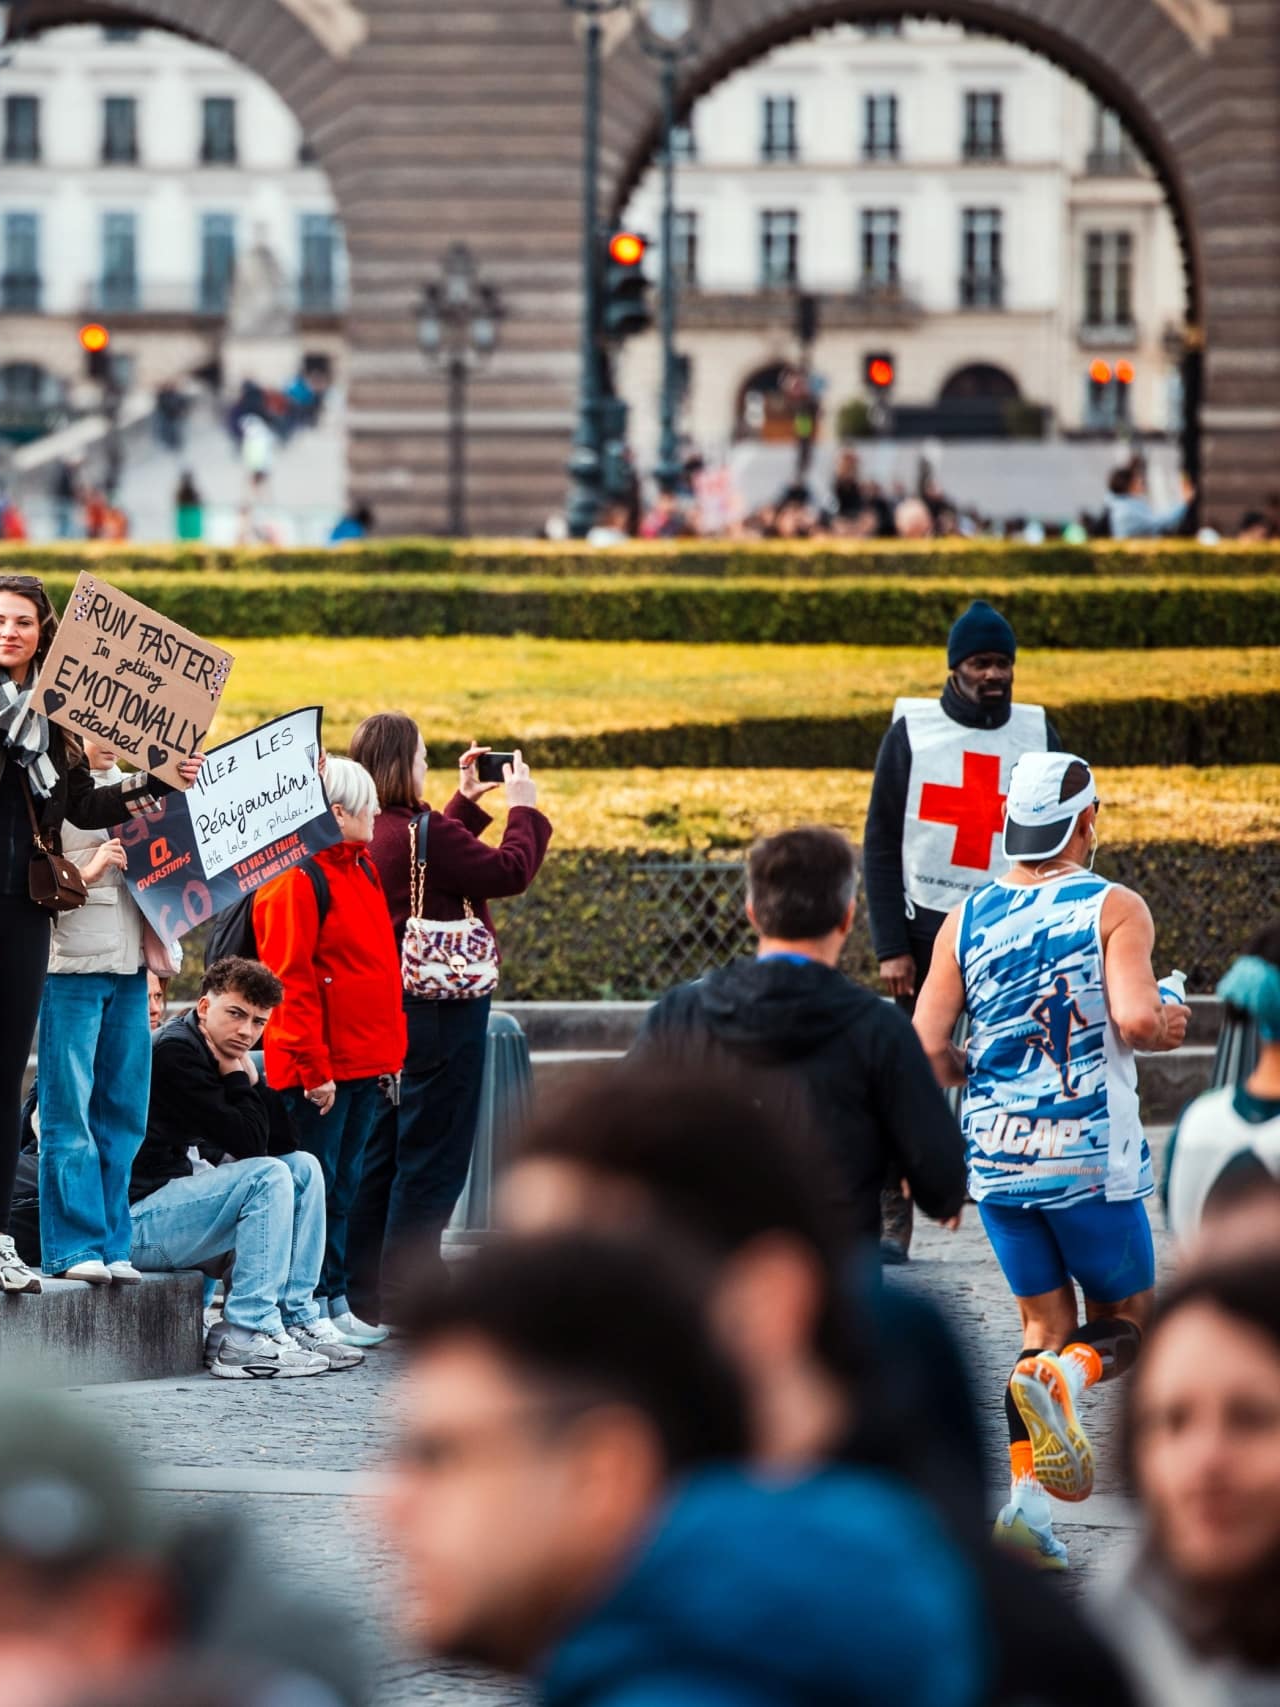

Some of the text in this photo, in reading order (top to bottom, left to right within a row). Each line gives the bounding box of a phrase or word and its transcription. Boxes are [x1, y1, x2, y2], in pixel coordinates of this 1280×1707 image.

[86, 594, 216, 690] RUN FASTER
[115, 658, 167, 694] getting
[54, 655, 207, 755] EMOTIONALLY
[69, 707, 145, 755] attached
[196, 727, 294, 796] LLEZ LES
[247, 852, 266, 870] VAS
[265, 846, 276, 860] LE
[274, 832, 300, 853] FAIRE
[280, 854, 291, 868] LA
[979, 1113, 1082, 1158] JCAP
